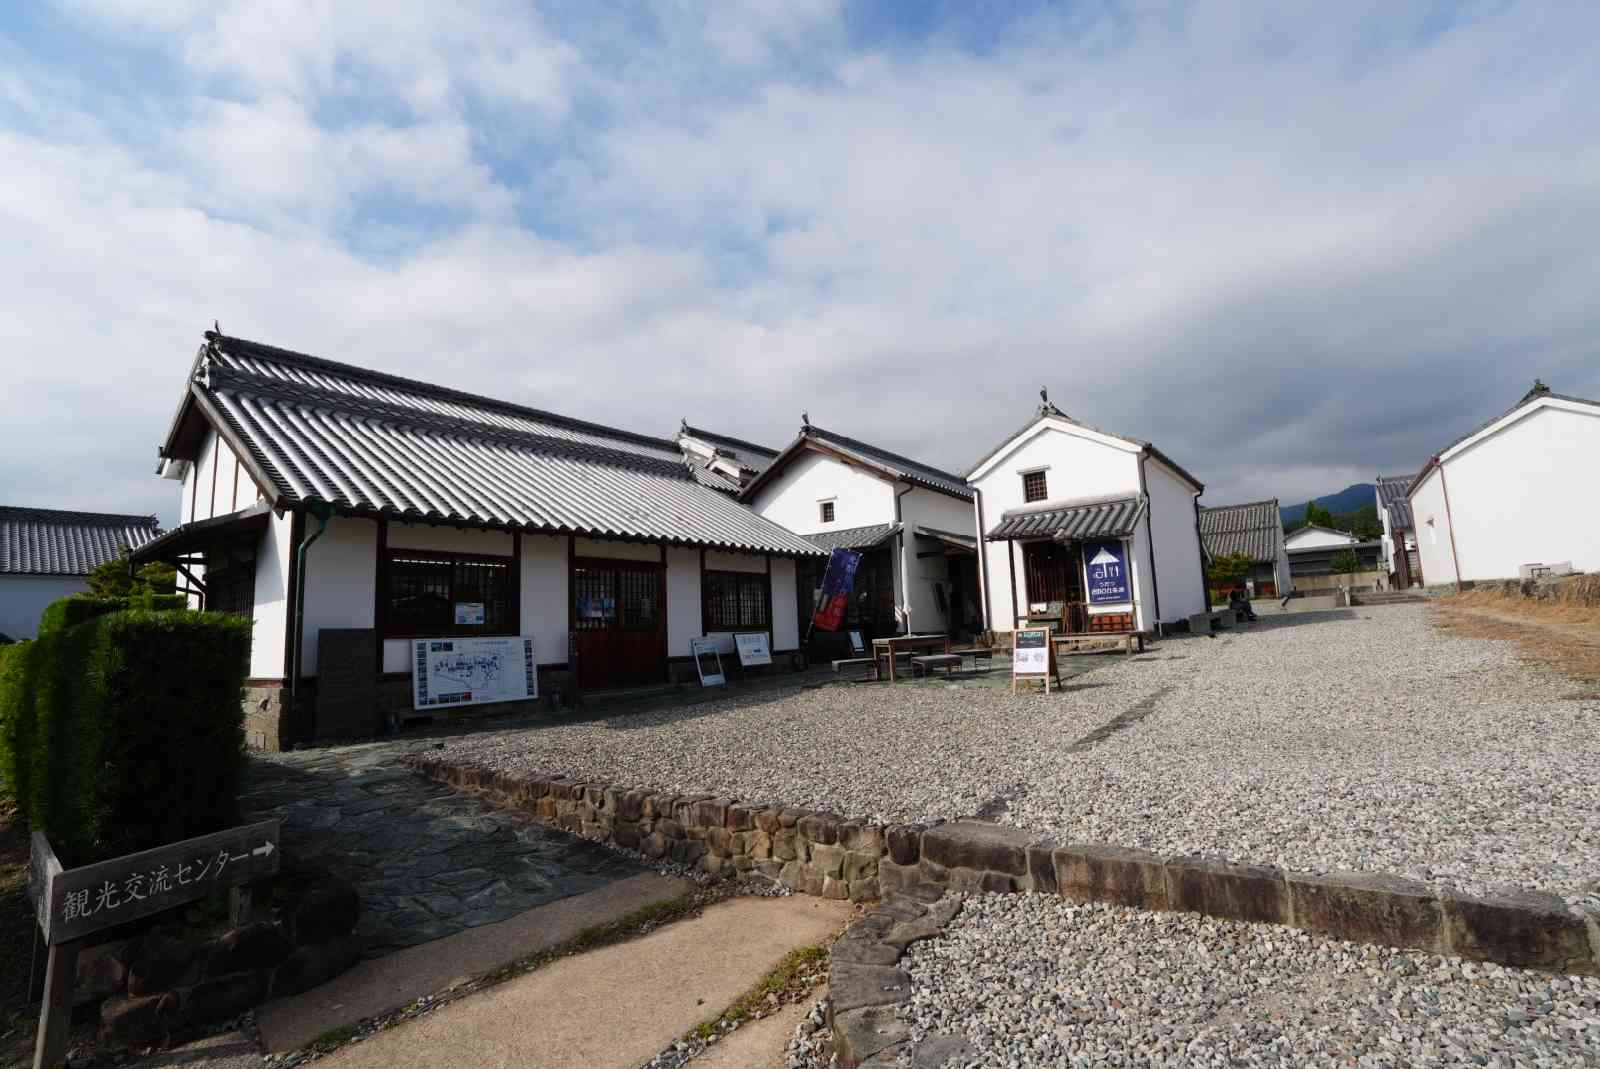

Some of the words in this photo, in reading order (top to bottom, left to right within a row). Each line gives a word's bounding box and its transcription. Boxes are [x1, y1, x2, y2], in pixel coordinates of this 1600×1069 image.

[62, 850, 249, 923] 観光交流センター
